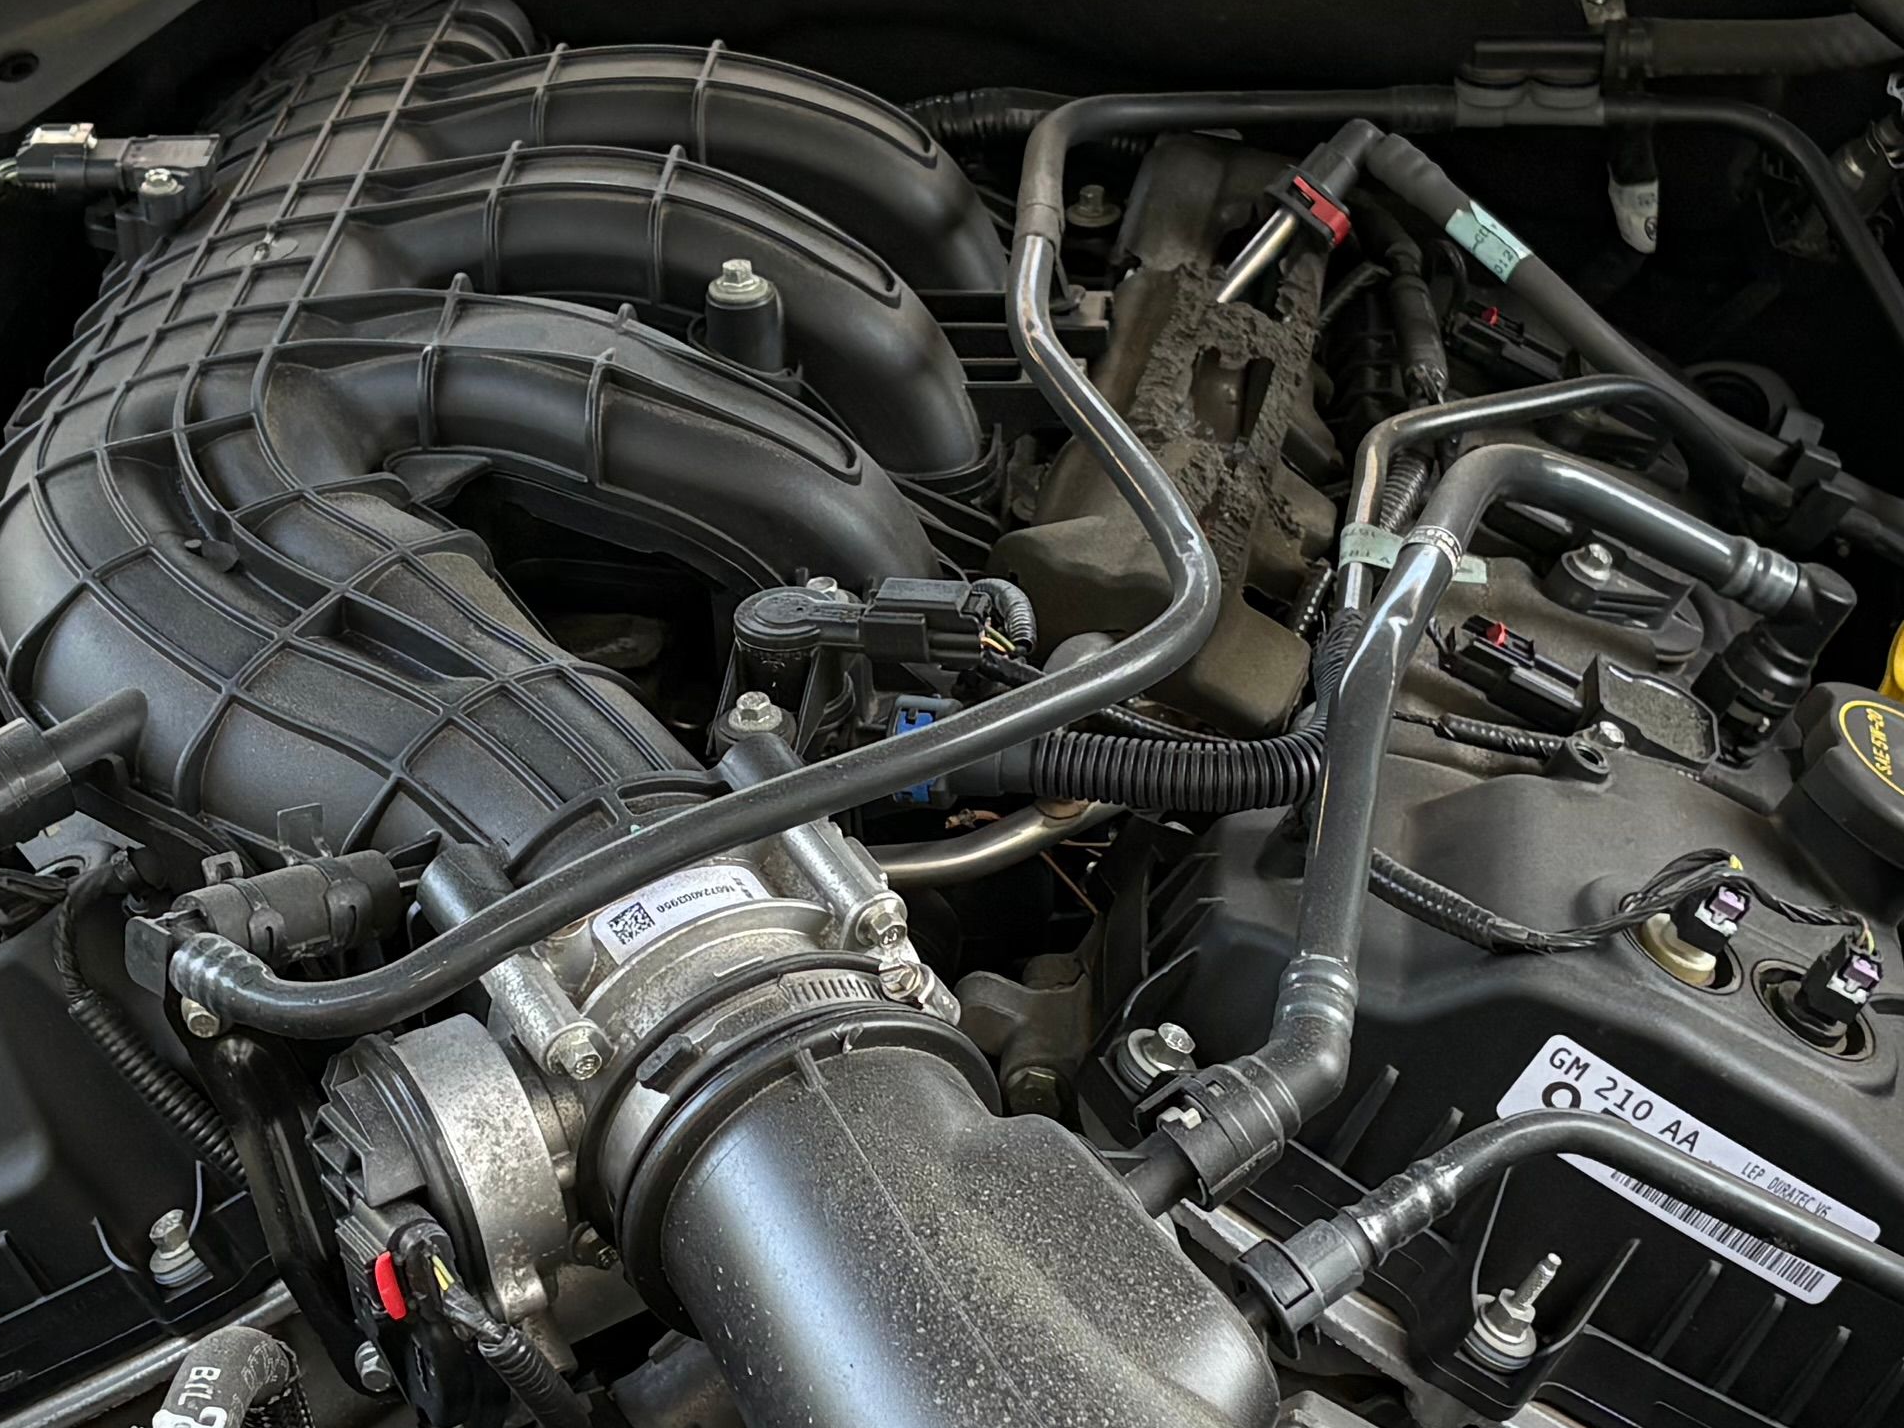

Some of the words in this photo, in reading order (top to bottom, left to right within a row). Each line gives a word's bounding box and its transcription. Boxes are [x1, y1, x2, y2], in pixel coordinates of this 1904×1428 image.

[1550, 1047, 1590, 1082] GM
[1593, 1077, 1656, 1122] 210
[1661, 1119, 1701, 1154] AA
[1741, 1160, 1767, 1182] LEP
